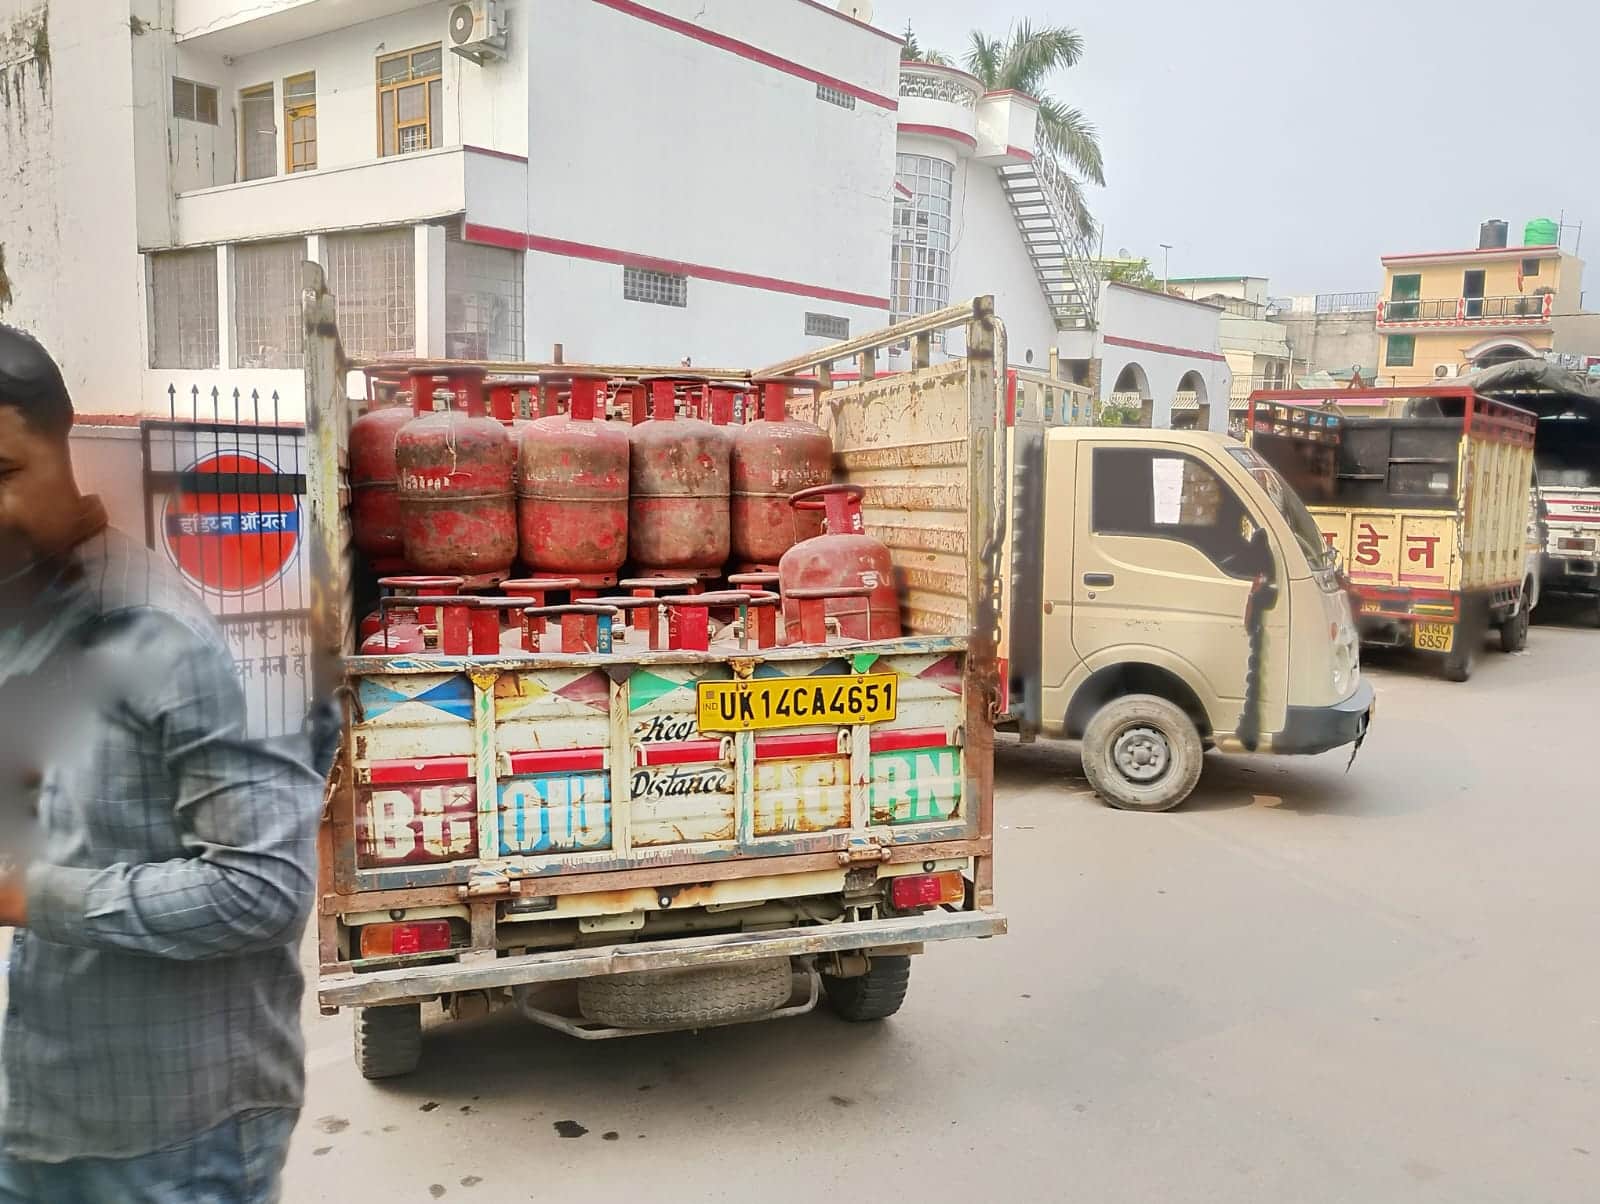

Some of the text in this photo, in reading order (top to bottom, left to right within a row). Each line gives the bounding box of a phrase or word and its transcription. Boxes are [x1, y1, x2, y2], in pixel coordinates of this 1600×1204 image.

[240, 511, 288, 532] ऑयल
[1418, 633, 1449, 649] 6857
[702, 682, 893, 722] IND UK14CA4651
[630, 766, 728, 803] Distance
